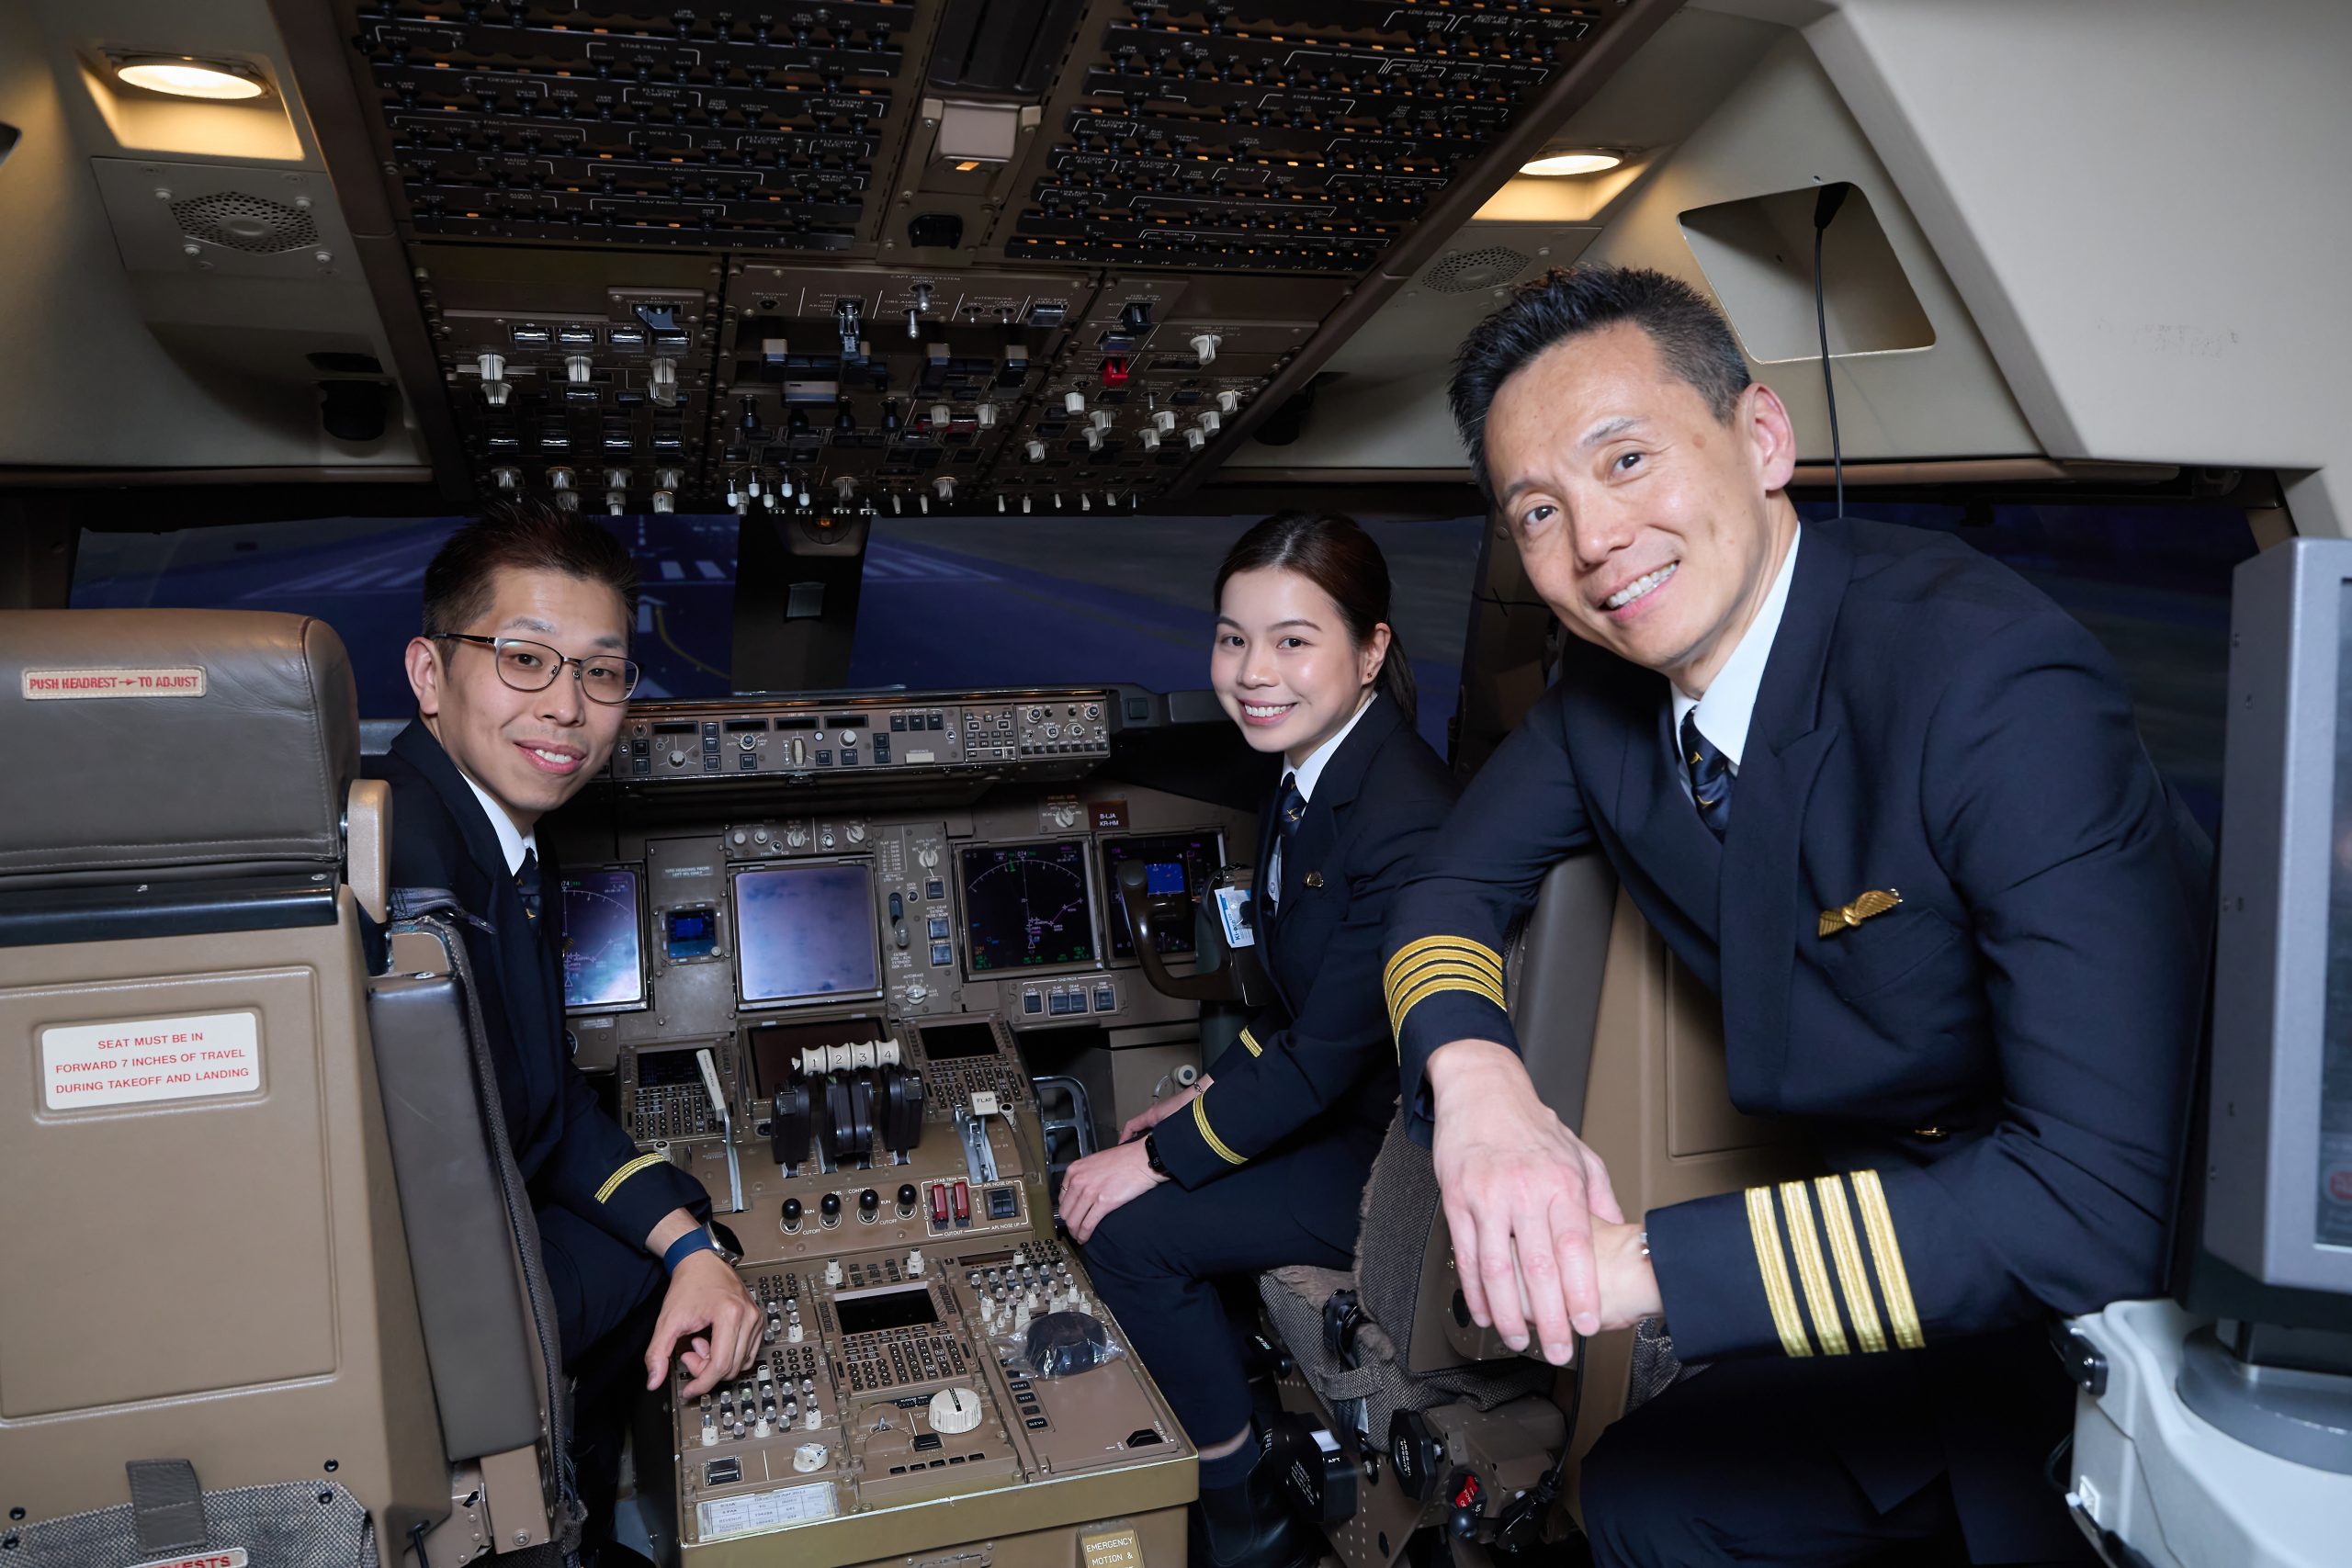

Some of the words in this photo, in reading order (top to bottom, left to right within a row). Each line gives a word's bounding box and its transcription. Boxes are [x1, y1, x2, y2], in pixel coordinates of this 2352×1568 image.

[29, 678, 59, 690] PUSH
[62, 677, 117, 689] HEADREST
[139, 676, 152, 688] TO
[156, 676, 198, 688] ADJUST
[98, 1038, 130, 1050] SEAT
[134, 1035, 167, 1047] MUST
[172, 1033, 187, 1043] BE
[191, 1032, 203, 1042] IN
[56, 1059, 117, 1074] FORWARD
[122, 1059, 128, 1067] 7
[131, 1055, 177, 1067] INCHES
[180, 1053, 197, 1062] OF
[200, 1049, 245, 1060] TRAVEL
[56, 1080, 103, 1094] DURING
[108, 1076, 162, 1089] TAKEOFF
[166, 1073, 191, 1084] AND
[196, 1068, 249, 1081] LANDING
[1399, 1440, 1408, 1472] LUMBAR
[1403, 1438, 1412, 1476] UP-DOWN
[1086, 1537, 1133, 1552] EMERGENCY
[1091, 1554, 1123, 1566] MOTION
[1126, 1551, 1133, 1560] &
